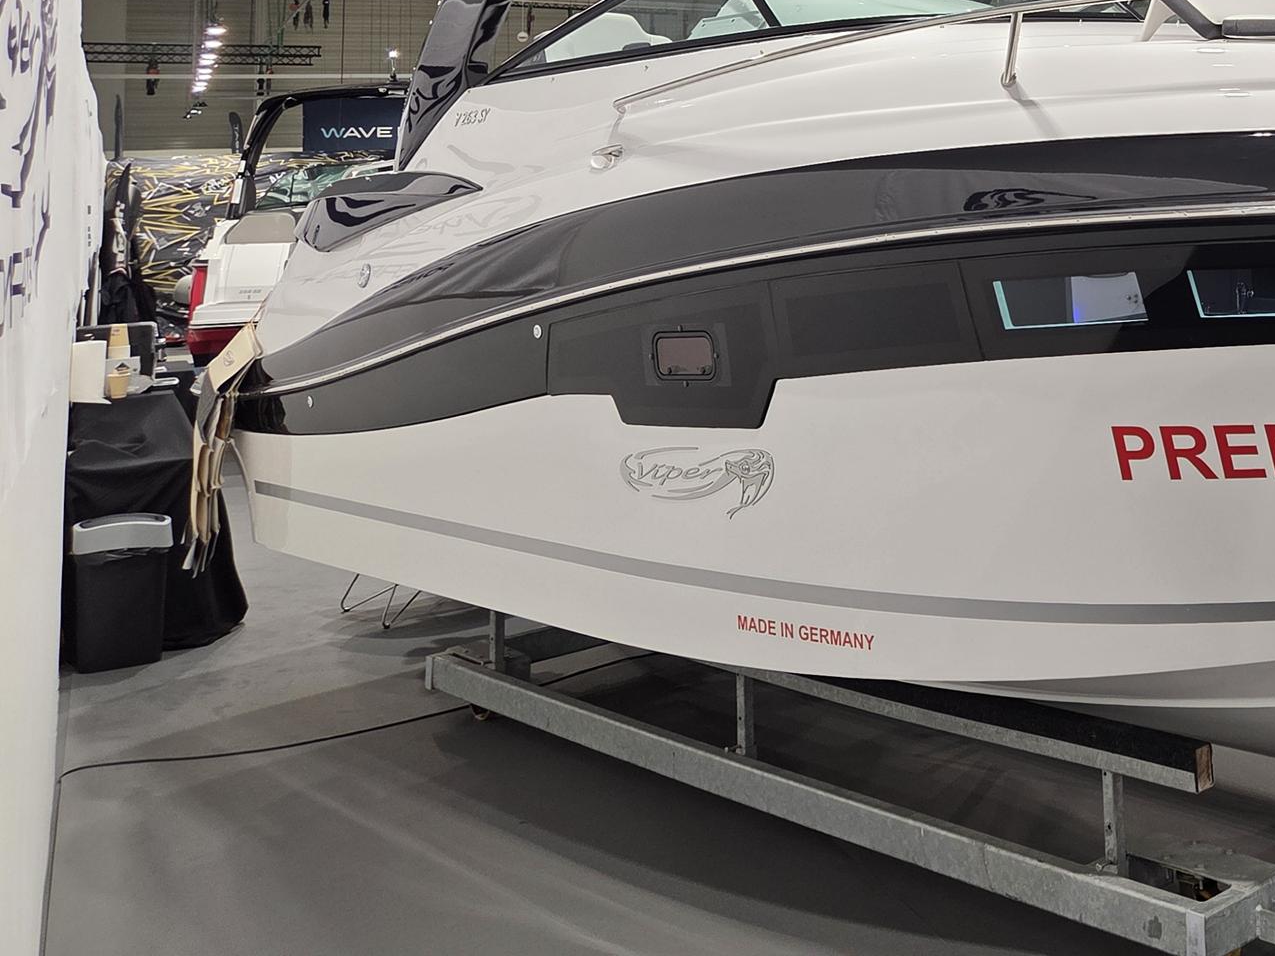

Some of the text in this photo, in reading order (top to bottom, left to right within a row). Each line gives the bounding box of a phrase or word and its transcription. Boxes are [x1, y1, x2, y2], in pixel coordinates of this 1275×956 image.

[320, 126, 393, 139] WAVE
[637, 461, 724, 487] Viper
[737, 614, 875, 651] MADE IN GERMANY
